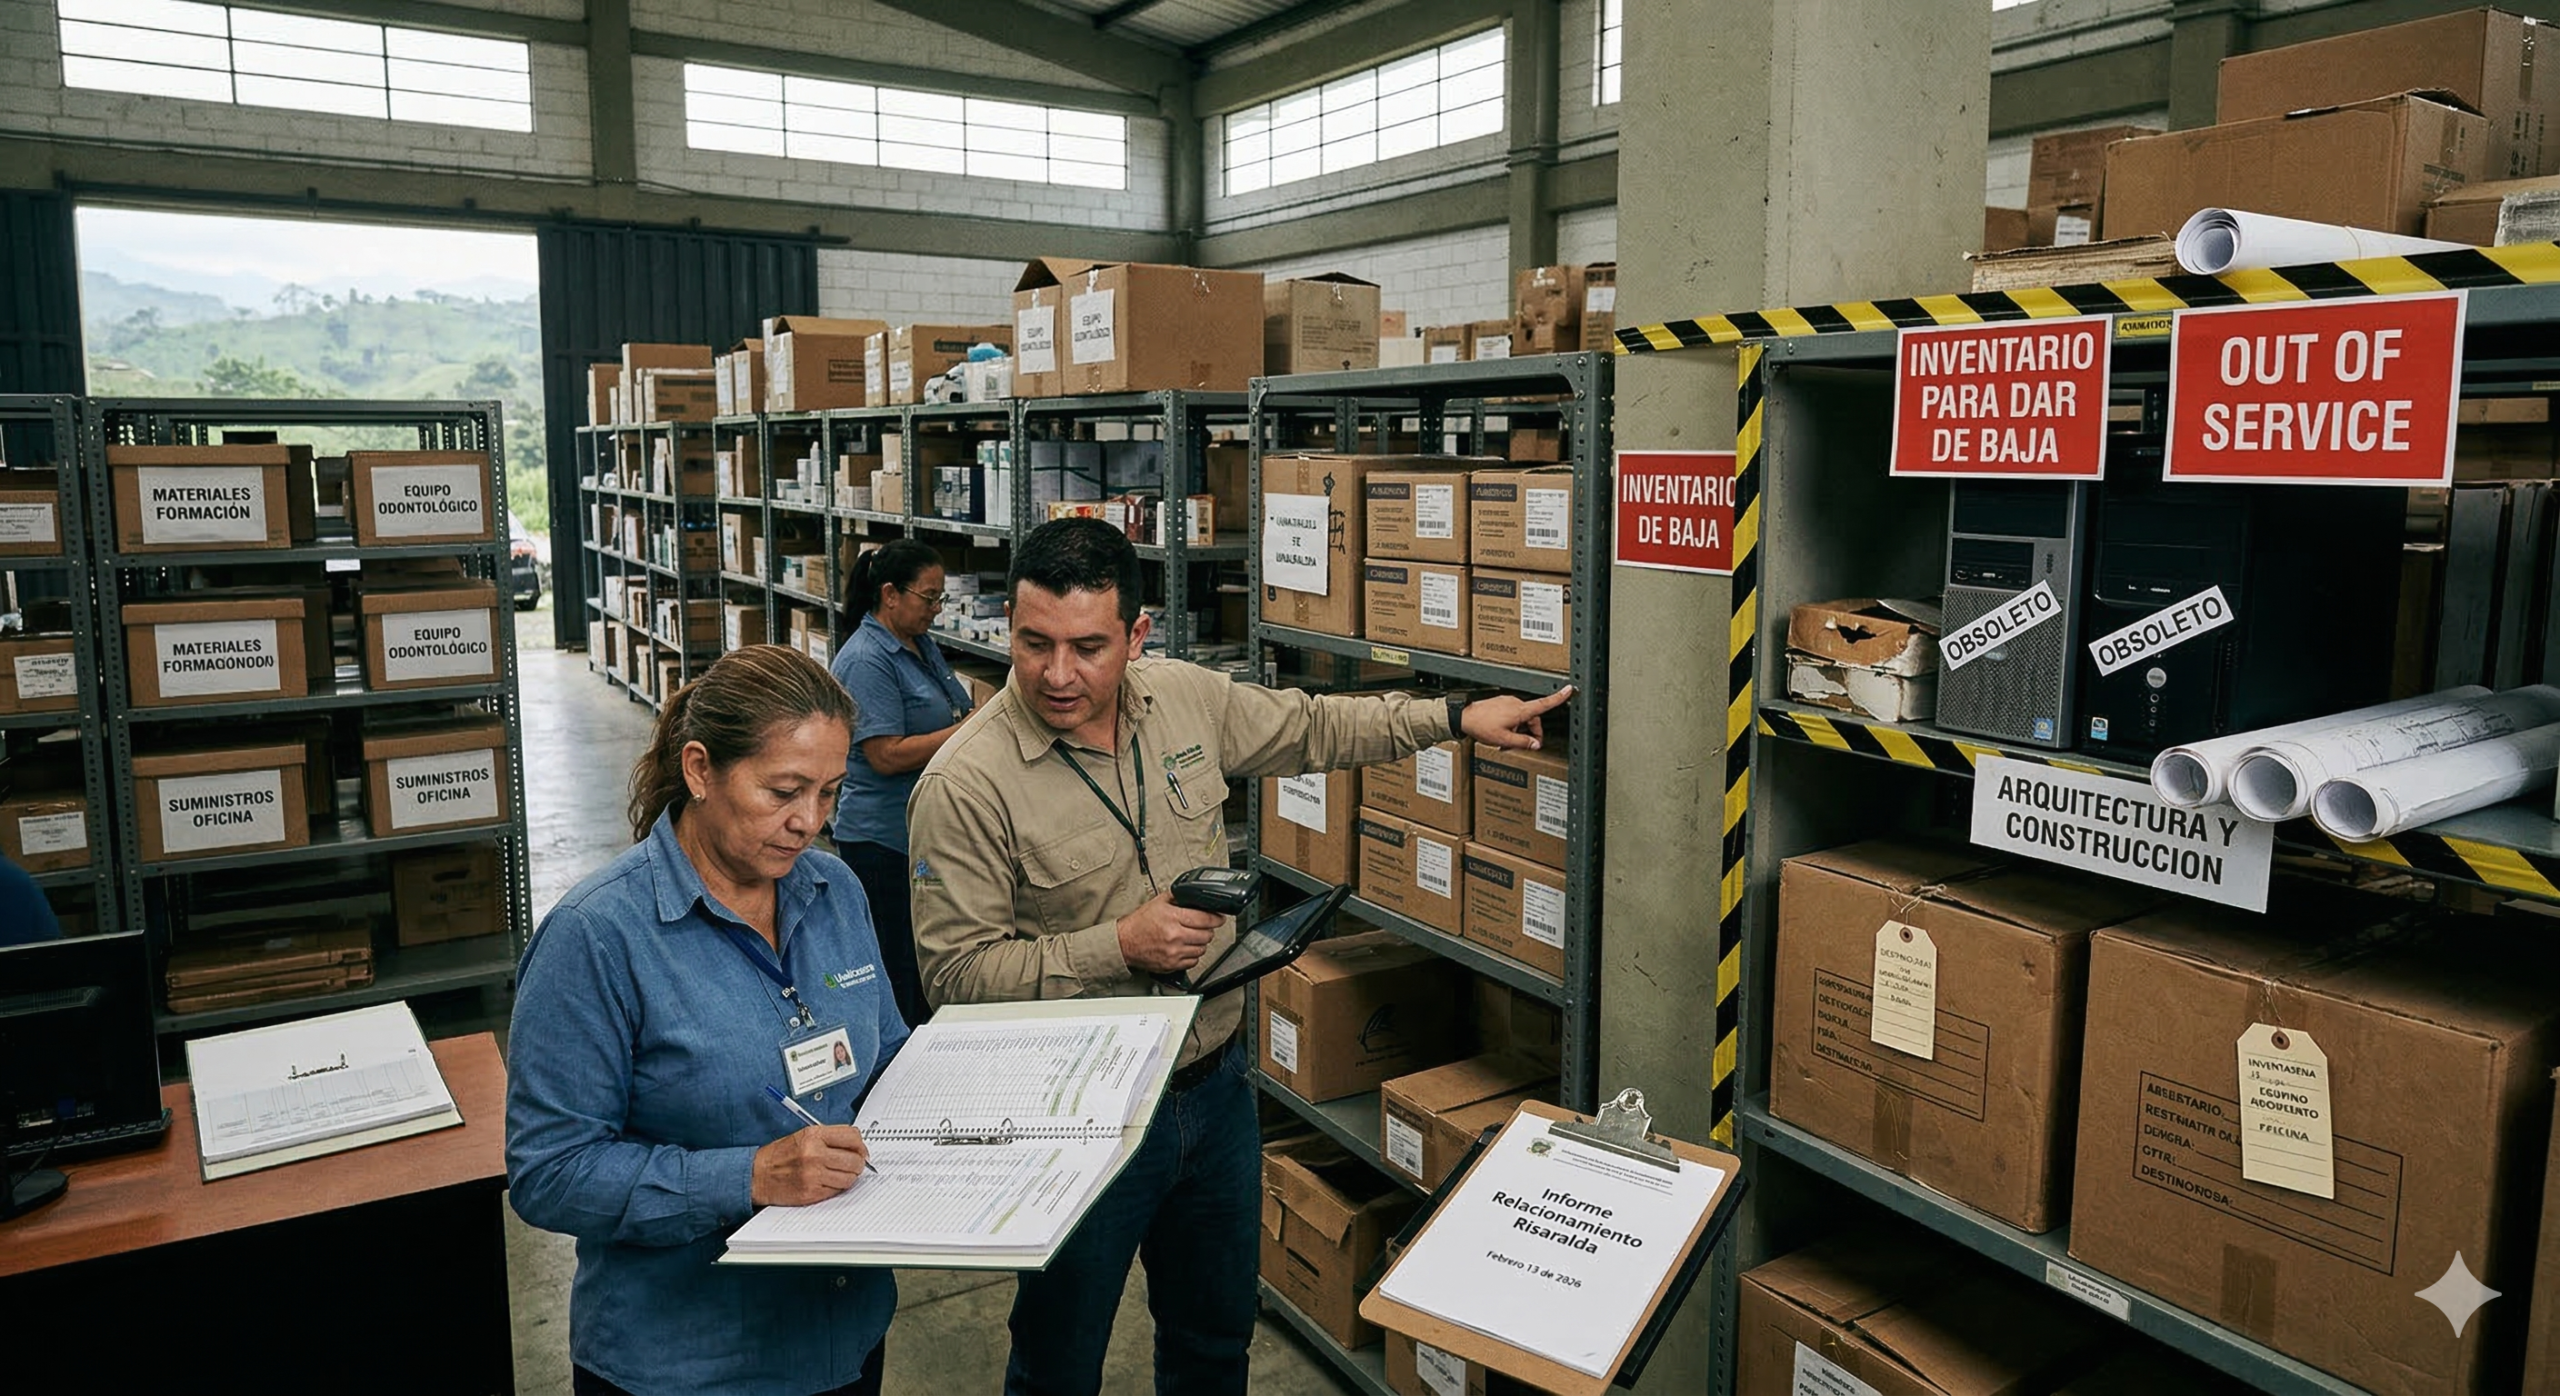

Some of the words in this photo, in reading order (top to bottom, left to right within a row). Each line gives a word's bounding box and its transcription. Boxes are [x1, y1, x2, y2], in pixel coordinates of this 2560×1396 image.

[1910, 332, 2095, 376] INVENTARIO
[2220, 333, 2319, 386] OUT
[2334, 329, 2403, 382] OF
[1921, 383, 2000, 419] PARA
[2010, 381, 2076, 418] DAR
[2202, 400, 2412, 452] SERVICE
[1932, 428, 1970, 462] DE
[1980, 428, 2059, 463] BAJA
[153, 487, 251, 502] MATERIALES
[378, 498, 478, 514] ODONTOLÓGICO
[404, 484, 451, 498] EQUIPO
[156, 502, 251, 520] FORMACIÓN
[1638, 515, 1662, 544] DE
[1669, 516, 1720, 549] BAJA
[414, 627, 461, 641] EQUIPO
[1946, 590, 2052, 661] OBSOLETO
[2098, 596, 2222, 666] OBSOLETO
[173, 639, 261, 656] MATERIALES
[388, 641, 487, 659] ODONTOLÓGICO
[396, 768, 489, 789] SUMINISTROS
[168, 790, 274, 812] SUMINISTROS
[417, 787, 471, 804] OFICINA
[1997, 775, 2208, 841] ARQUITECTURA
[2218, 817, 2238, 847] Y
[193, 810, 253, 827] OFICINA
[2006, 812, 2223, 885] CONSTRUCCION
[1541, 1188, 1613, 1219] Informe
[1492, 1191, 1643, 1248] Relacionamiento
[1513, 1217, 1599, 1254] Risaralda
[1486, 1250, 1525, 1269] Febrero
[1526, 1263, 1540, 1274] 13
[1540, 1269, 1554, 1279] de
